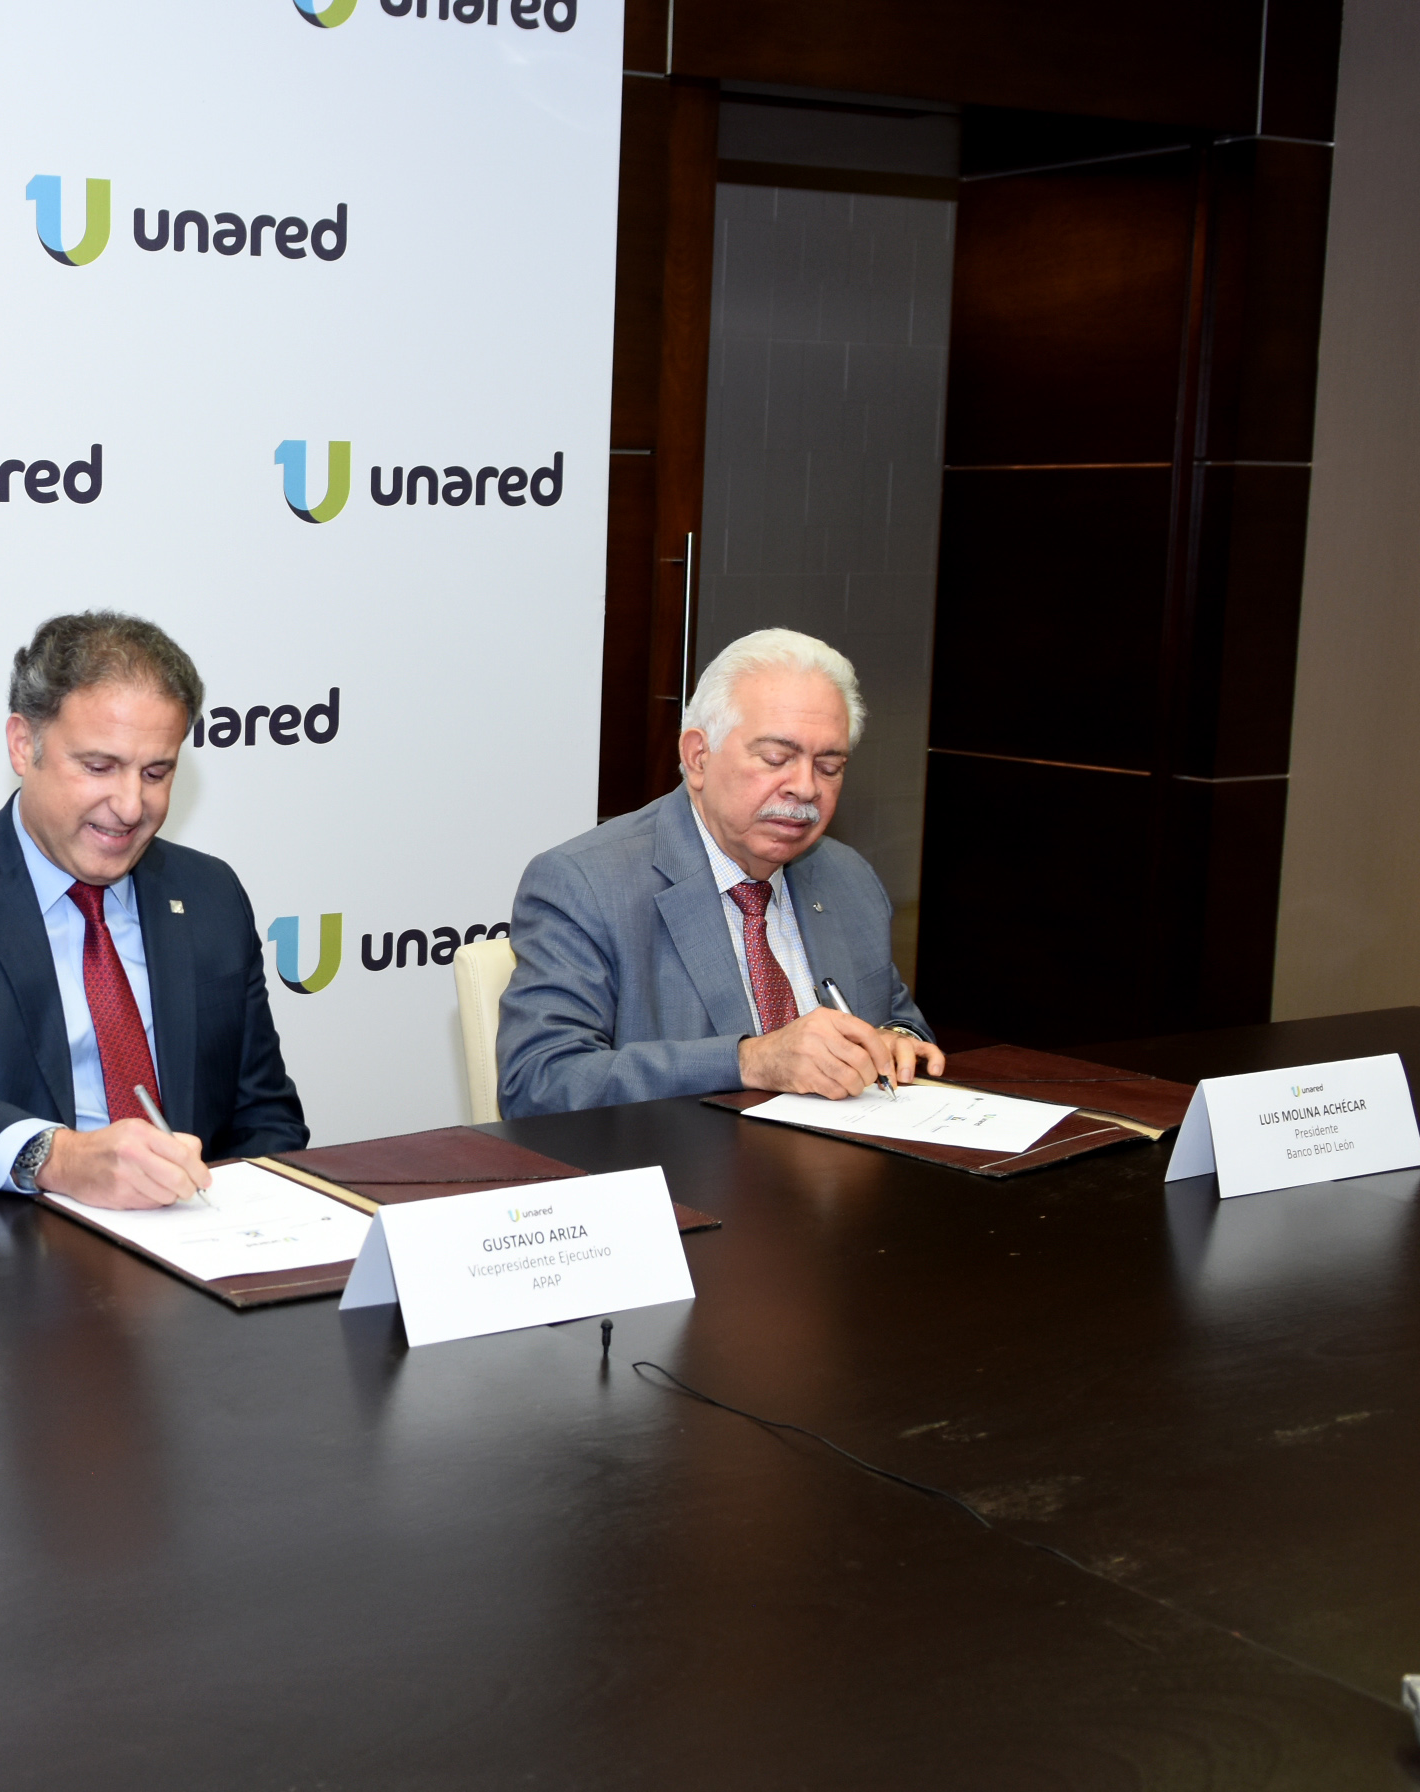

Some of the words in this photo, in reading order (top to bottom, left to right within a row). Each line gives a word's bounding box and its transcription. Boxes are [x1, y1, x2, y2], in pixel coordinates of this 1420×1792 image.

[133, 203, 348, 261] unared
[370, 451, 564, 506] unared
[1301, 1084, 1324, 1094] unared
[1259, 1111, 1280, 1125] LUIS
[1282, 1106, 1321, 1122] MOLINA
[1323, 1099, 1367, 1116] ACHÉCAR
[1294, 1124, 1339, 1139] Presidente
[1286, 1148, 1313, 1159] Banco
[1313, 1142, 1333, 1155] BHD
[1334, 1139, 1355, 1152] León
[521, 1205, 554, 1218] unared
[482, 1231, 545, 1252] GUSTAVO
[549, 1225, 588, 1242] ARIZA
[467, 1255, 556, 1277] Vicepresidente
[558, 1245, 612, 1266] Ejecutivo
[532, 1273, 563, 1290] APAP
